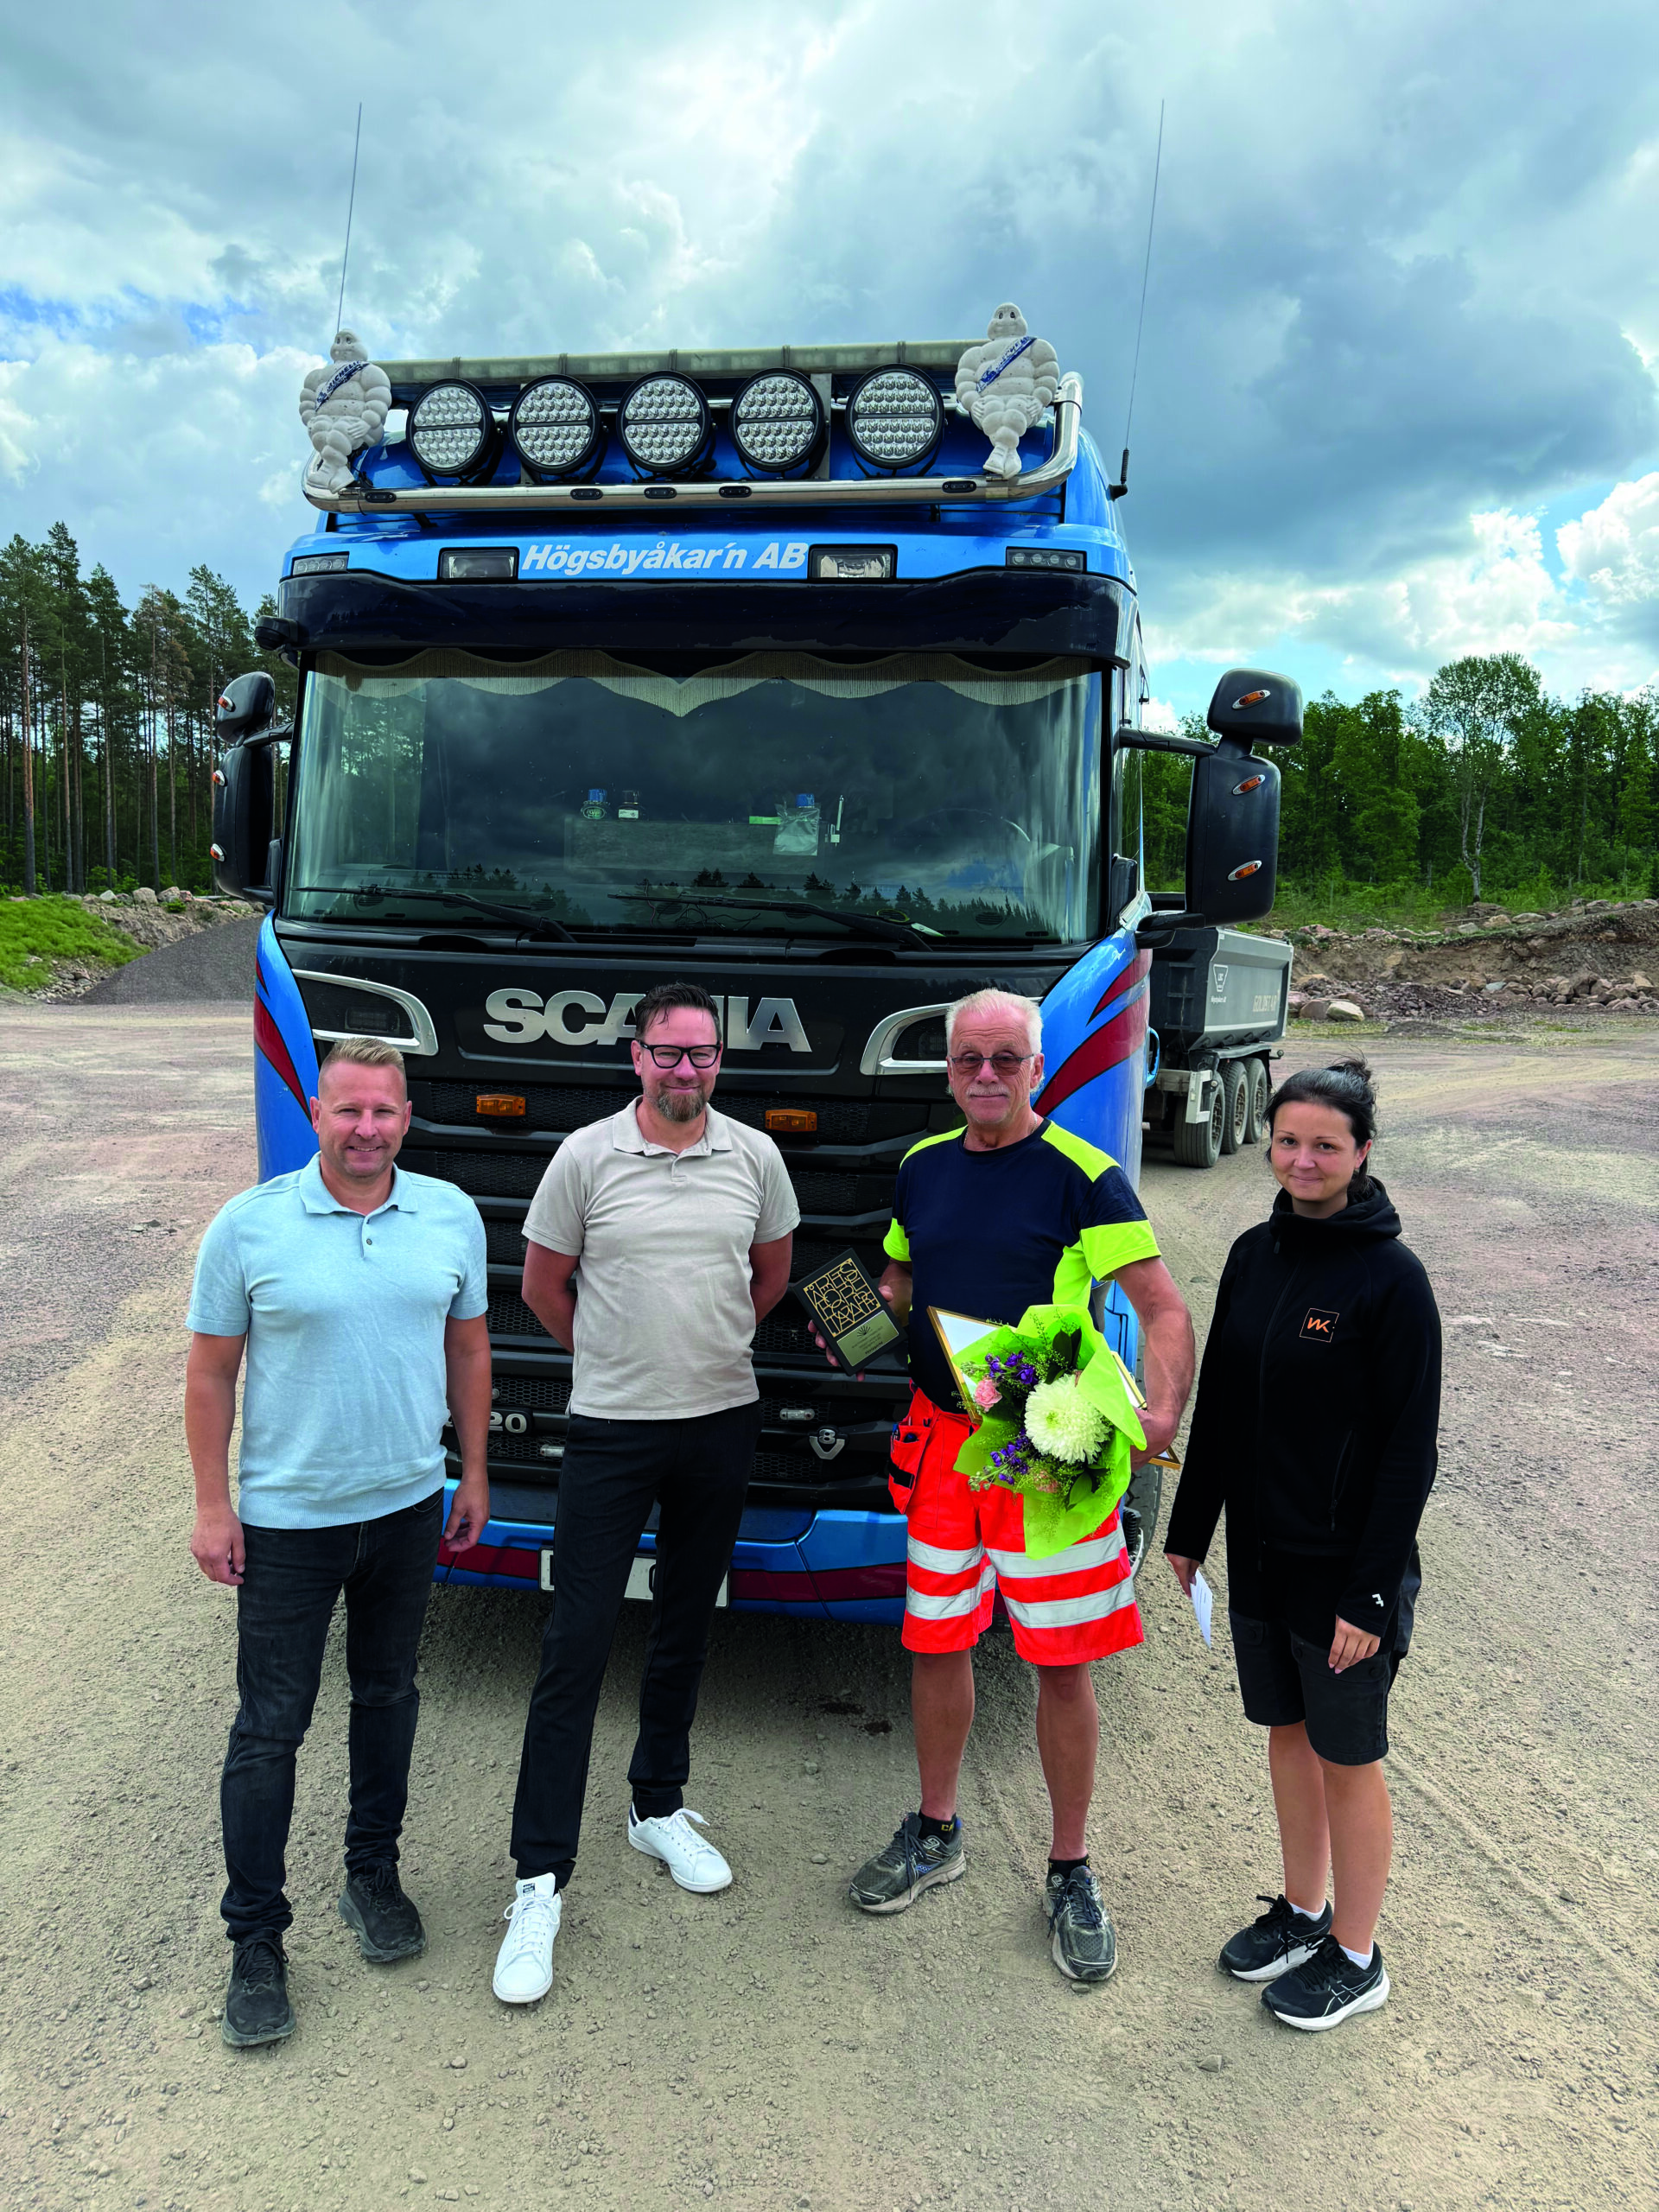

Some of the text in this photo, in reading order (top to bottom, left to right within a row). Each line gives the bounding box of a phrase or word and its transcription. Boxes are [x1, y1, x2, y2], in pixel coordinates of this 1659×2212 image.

[752, 542, 810, 569] AB
[483, 988, 812, 1052] SCAIA
[489, 1411, 527, 1433] 20
